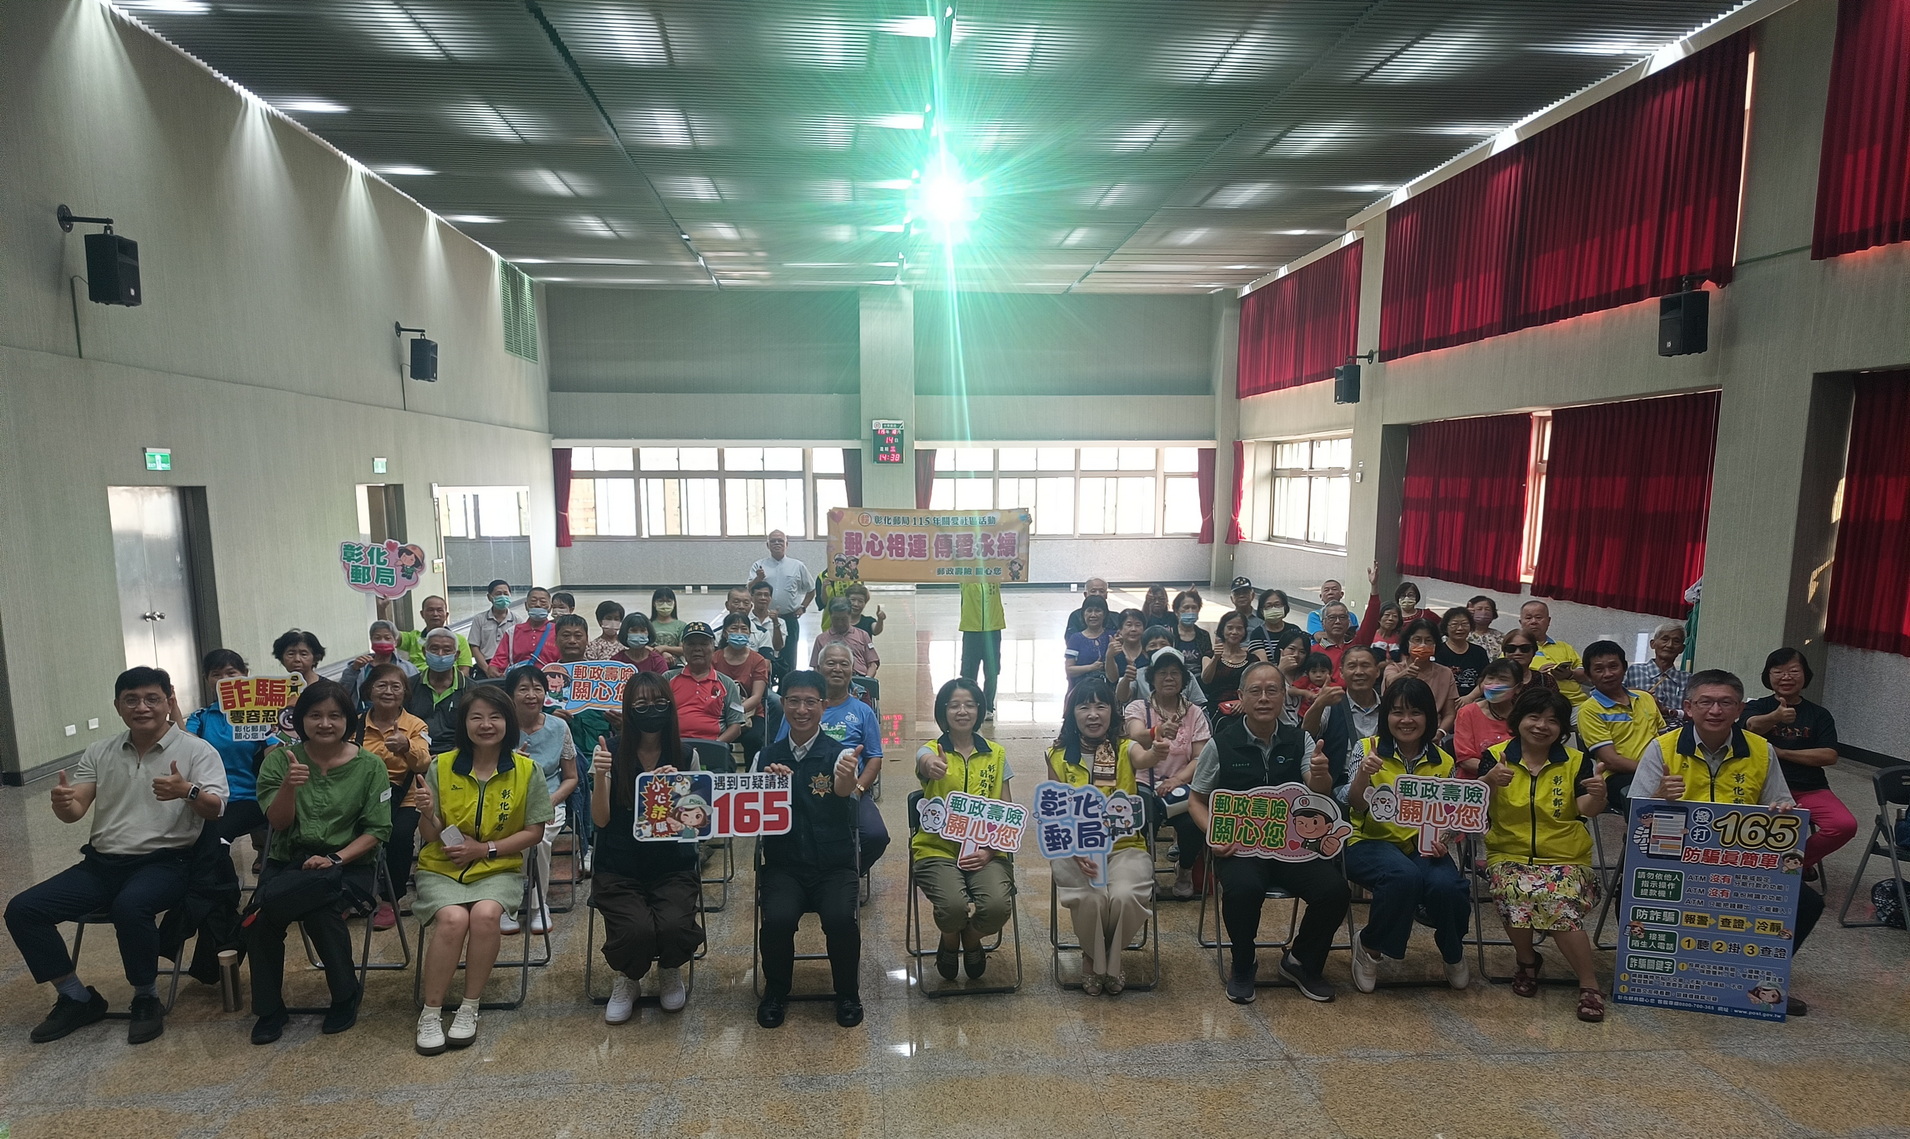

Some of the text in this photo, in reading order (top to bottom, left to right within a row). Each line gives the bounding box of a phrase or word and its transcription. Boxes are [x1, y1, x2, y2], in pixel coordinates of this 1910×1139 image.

[342, 543, 389, 566] 彰化
[844, 532, 1018, 559] 郵心相連 傳愛永續
[350, 564, 396, 587] 郵局
[573, 665, 634, 682] 郵政壽險
[219, 678, 287, 710] 詐騙
[230, 710, 277, 723] 零容忍
[714, 774, 789, 791] 遇到可疑請撥
[1399, 780, 1484, 804] 郵政壽險
[713, 791, 789, 834] 165
[950, 795, 1024, 826] 郵政壽險
[1040, 788, 1100, 819] 彰化
[1213, 794, 1288, 820] 郵政壽險
[1399, 799, 1481, 828] 關心您
[945, 813, 1019, 848] 關心您
[1044, 821, 1108, 852] 郵局
[1211, 816, 1286, 848] 關心您
[1711, 810, 1801, 851] 165
[1637, 871, 1681, 881] 請勿依他人
[1641, 880, 1676, 890] 指示操作
[1687, 873, 1707, 882] ATM
[1709, 873, 1732, 885] 沒有
[1684, 898, 1705, 907] ATM
[1685, 887, 1706, 895] ATM
[1708, 887, 1731, 899] 沒有
[1636, 909, 1675, 923] 防詐騙
[1684, 914, 1783, 933] 報警 查證 冷靜
[1631, 940, 1675, 951] 陌生人電話
[1629, 957, 1673, 972] 詐騙關鍵字
